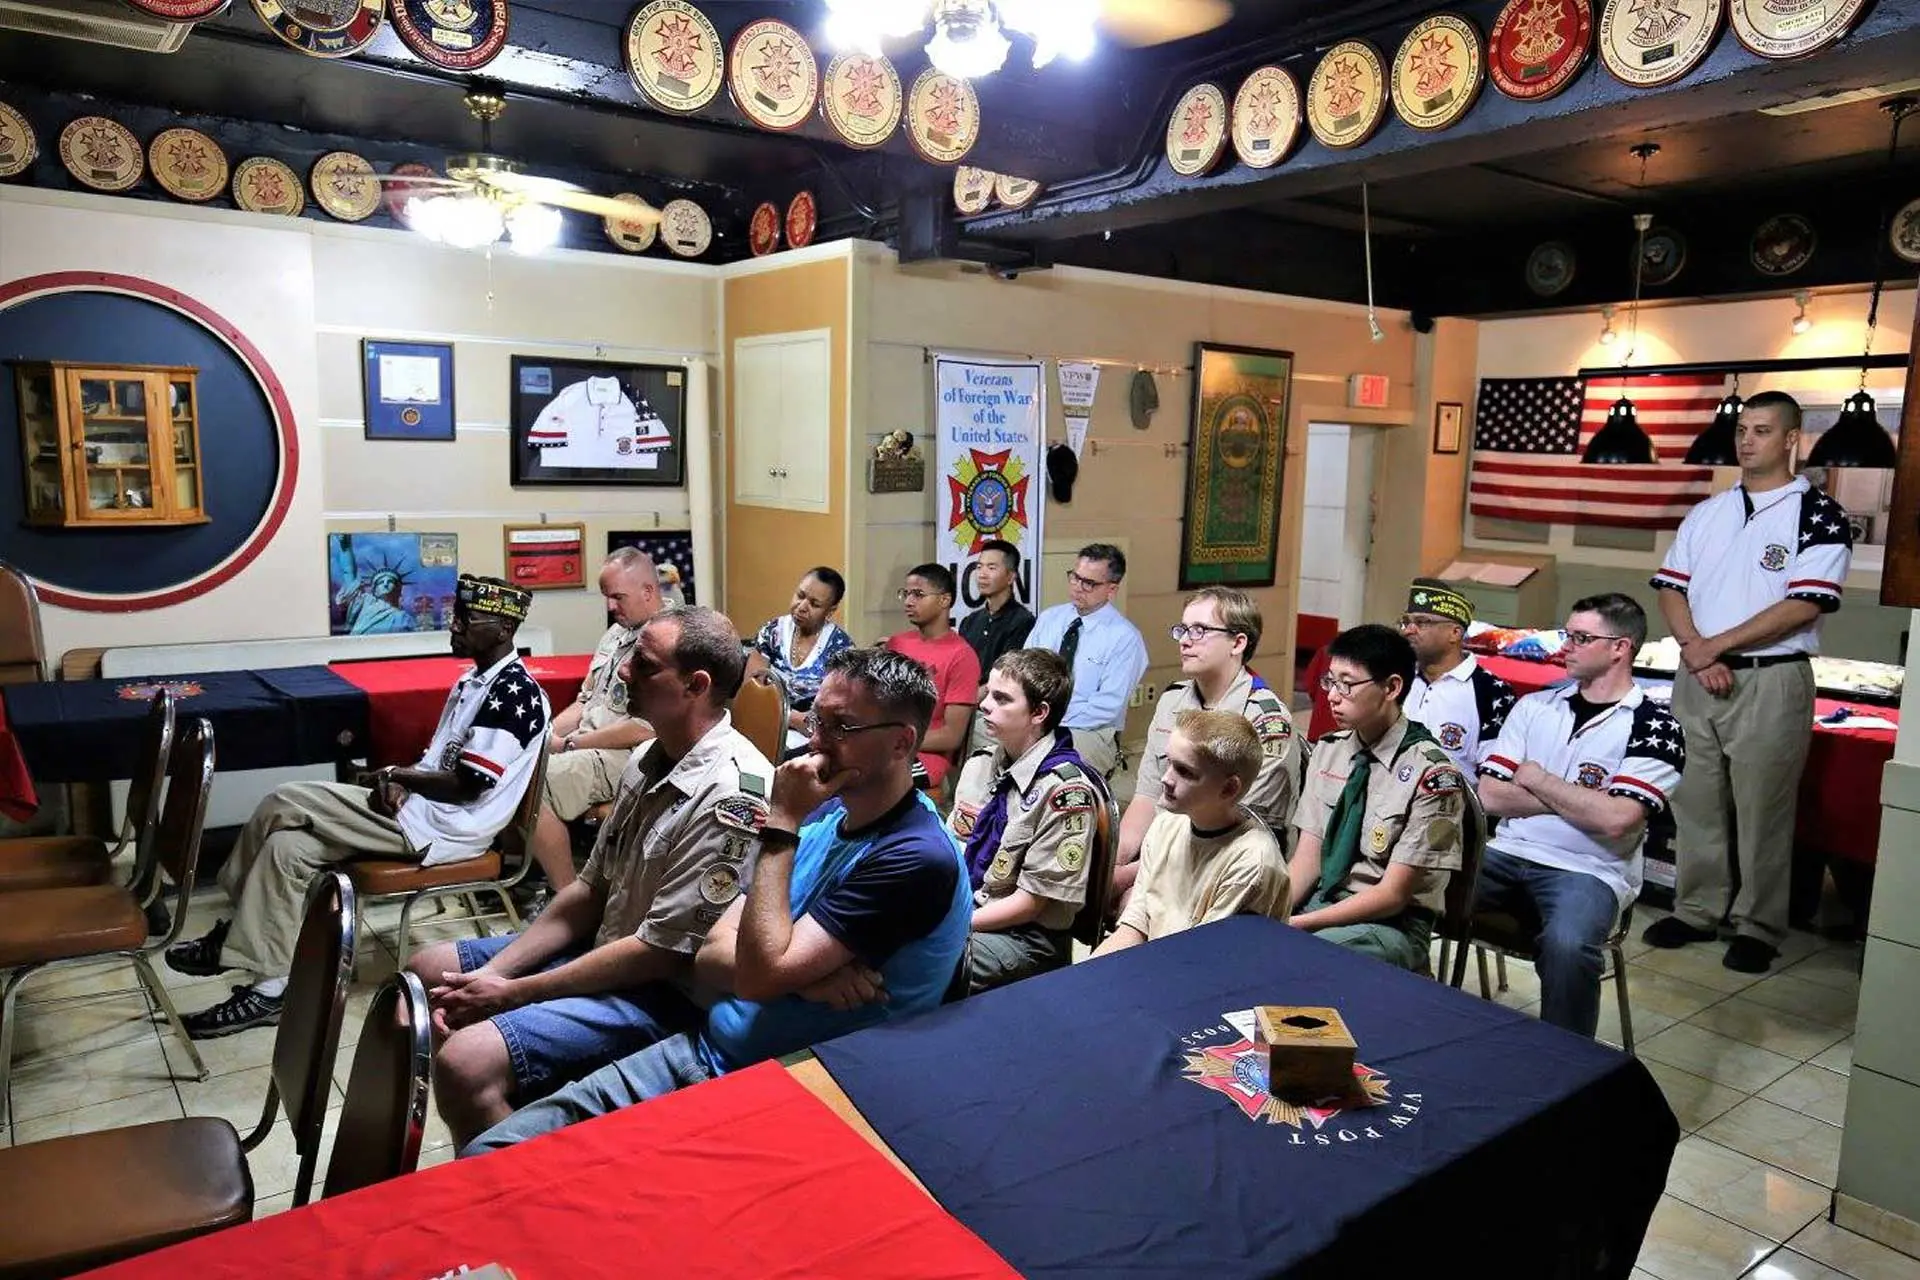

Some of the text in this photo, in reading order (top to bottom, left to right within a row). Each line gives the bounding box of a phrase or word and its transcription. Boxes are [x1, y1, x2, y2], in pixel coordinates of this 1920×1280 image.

[964, 369, 1014, 386] Veterans
[943, 387, 957, 403] of
[959, 387, 1001, 408] Foreign
[973, 409, 1006, 424] of the
[952, 426, 1029, 444] United States
[1064, 814, 1086, 830] 81
[1181, 1024, 1422, 1146] VFW POST 6033
